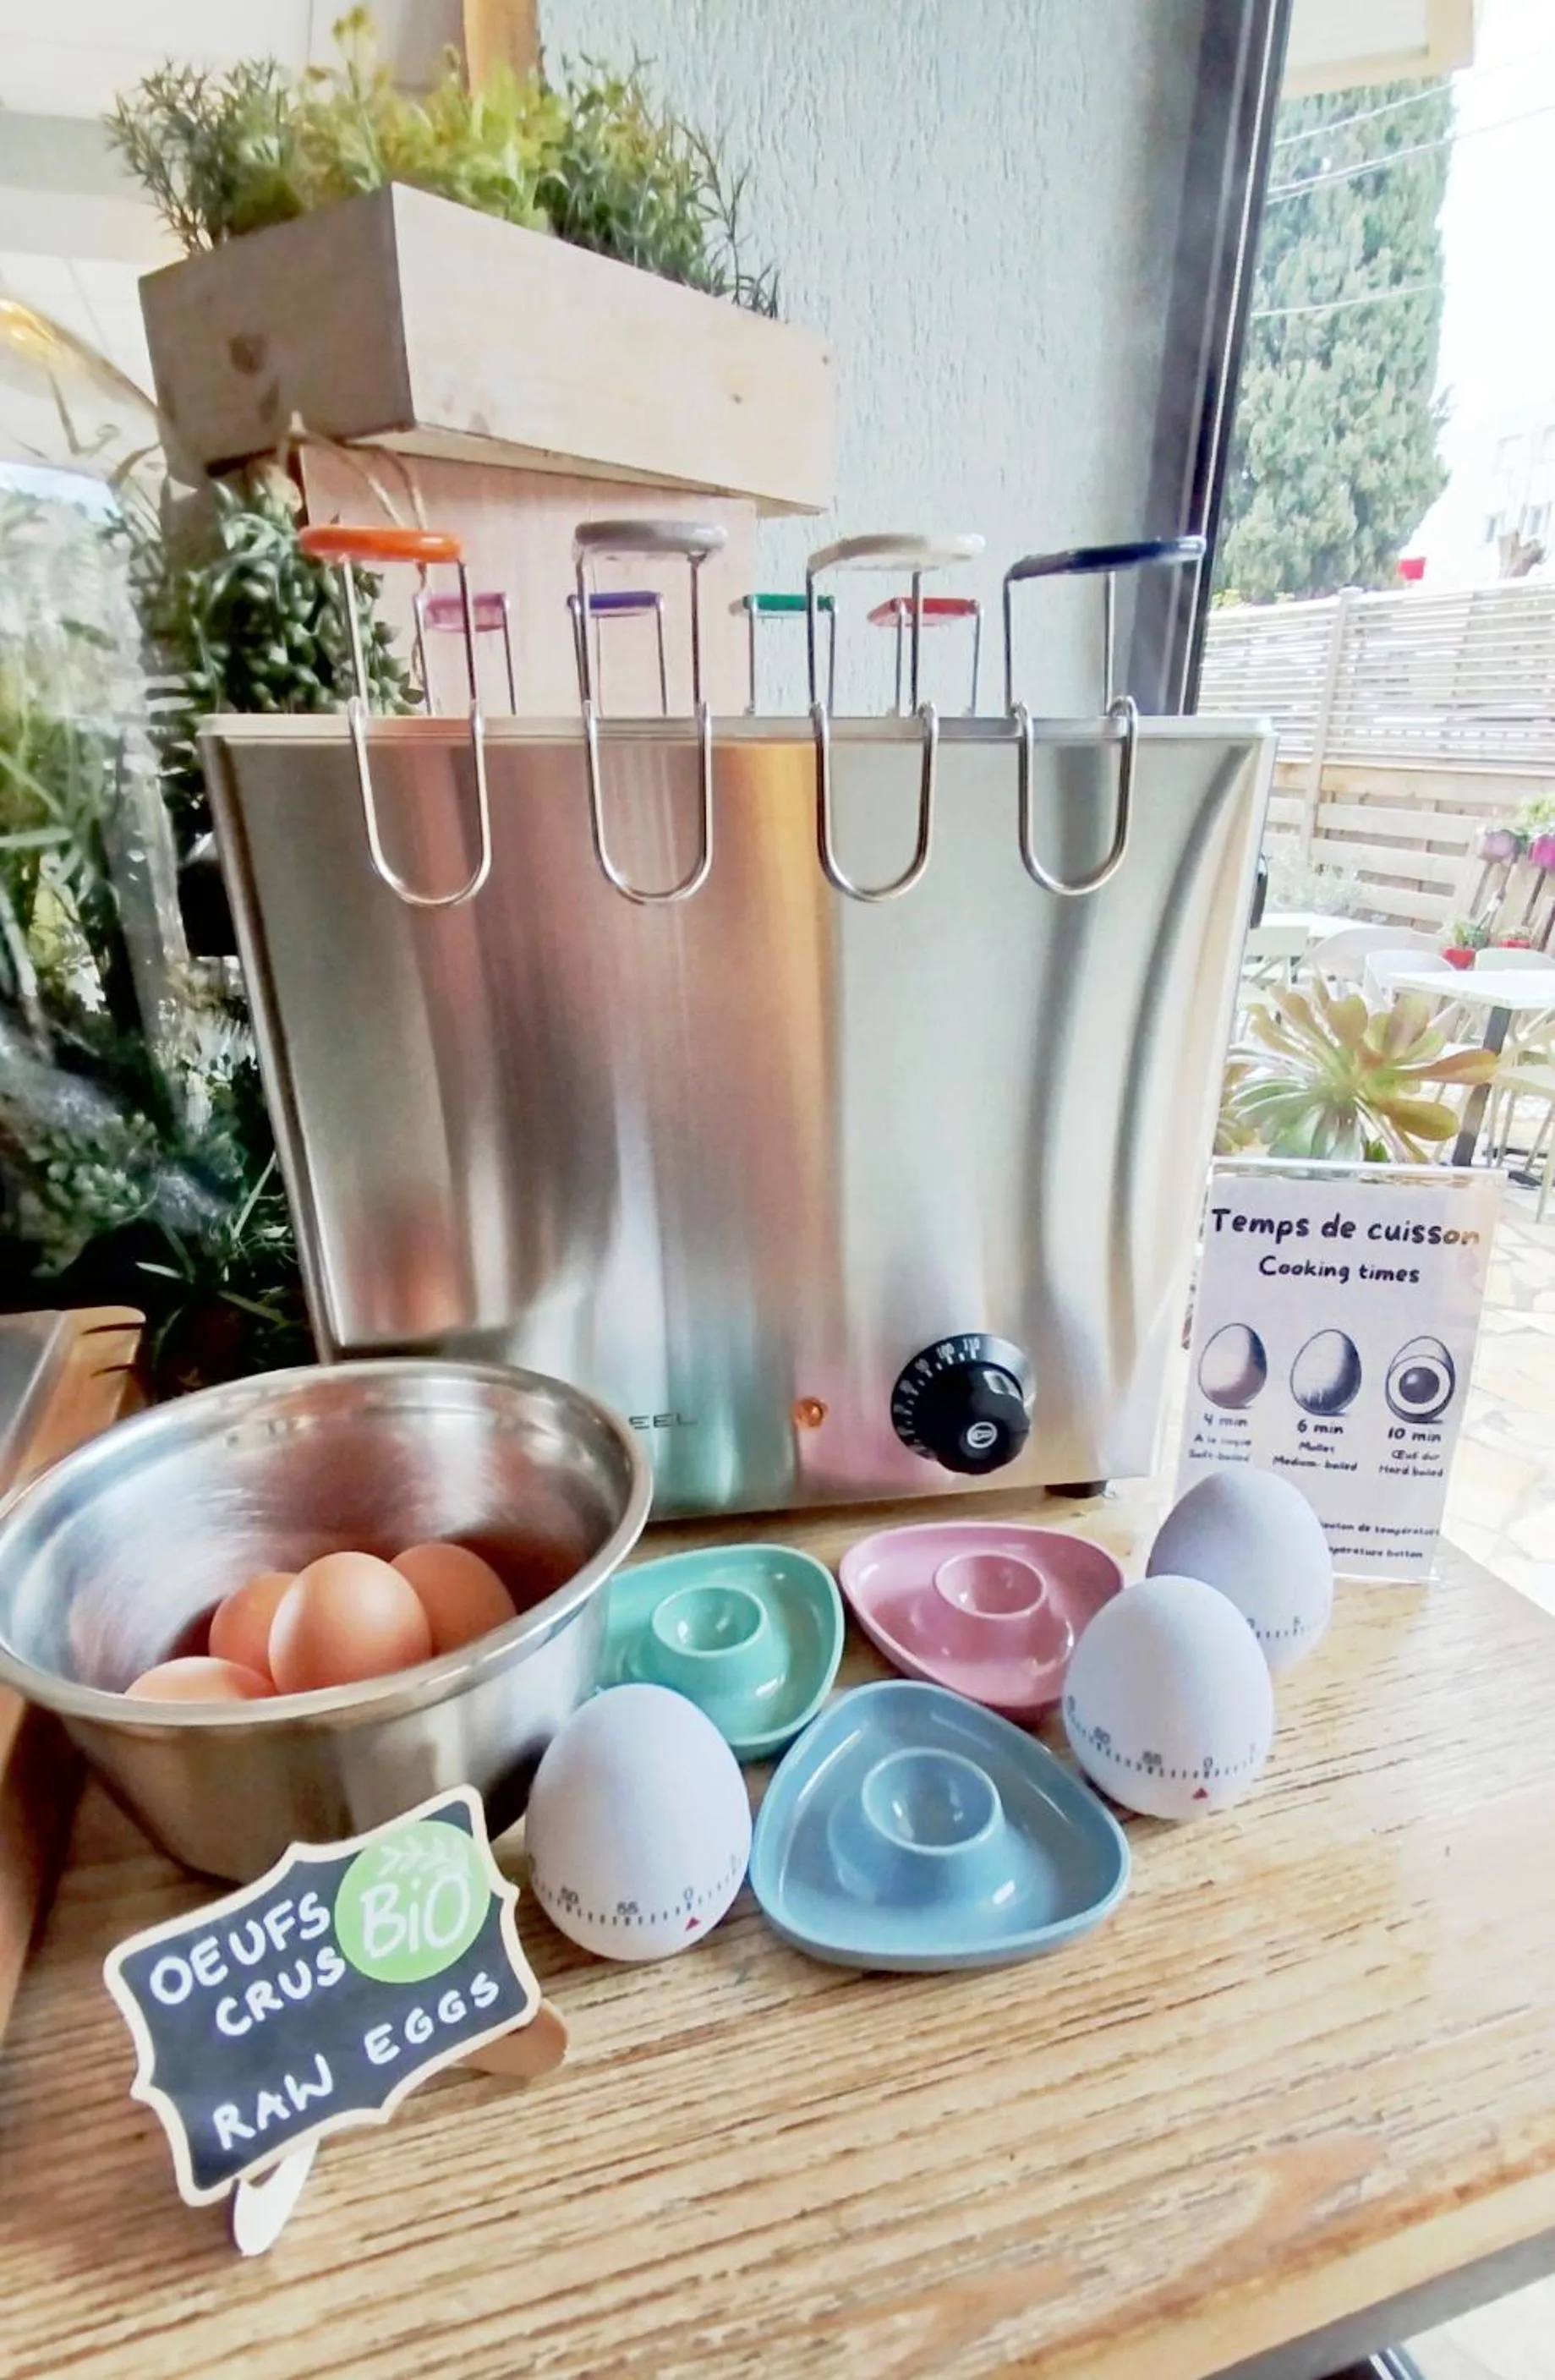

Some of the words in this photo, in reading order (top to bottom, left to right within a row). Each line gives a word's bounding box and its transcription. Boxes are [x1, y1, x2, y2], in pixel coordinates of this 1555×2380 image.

[1212, 1208, 1310, 1245] Temps
[1321, 1213, 1356, 1240] de
[1366, 1220, 1481, 1245] cuisson
[1258, 1255, 1350, 1284] Cooking
[1359, 1263, 1420, 1283] times
[1203, 1413, 1213, 1426] 4
[1218, 1417, 1248, 1427] min
[1296, 1420, 1308, 1433] 6
[1313, 1424, 1344, 1434] min
[1388, 1427, 1406, 1440] 10
[1411, 1432, 1442, 1442] min
[149, 1891, 331, 2005] OEUFS
[215, 1946, 348, 2037] CRUS
[212, 2054, 334, 2150] RAW
[364, 1972, 501, 2065] EGGS
